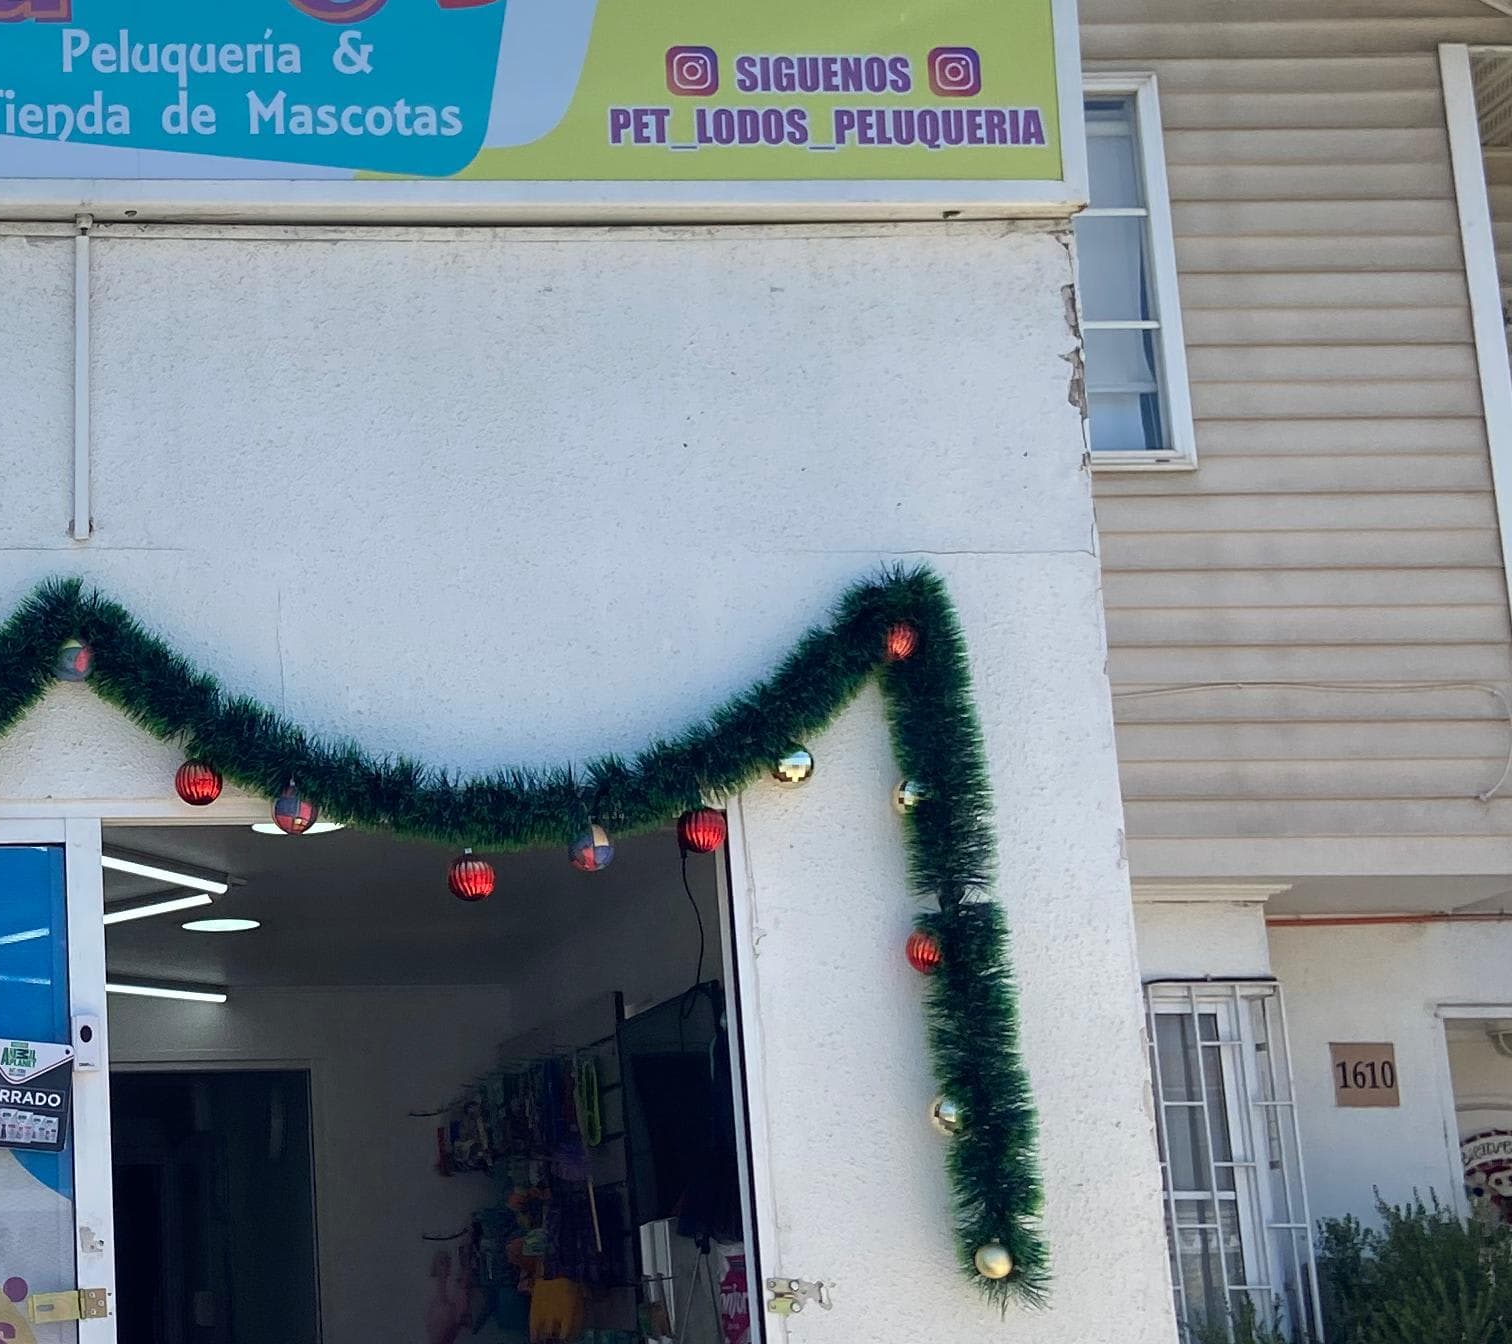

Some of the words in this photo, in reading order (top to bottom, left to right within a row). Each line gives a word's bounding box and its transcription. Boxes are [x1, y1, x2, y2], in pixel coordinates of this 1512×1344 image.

[61, 28, 302, 88] Peluquería
[333, 32, 374, 74] &
[736, 55, 912, 93] SIGUENOS
[162, 90, 217, 135] de
[248, 91, 463, 138] Mascotas
[1335, 1060, 1395, 1089] 1610
